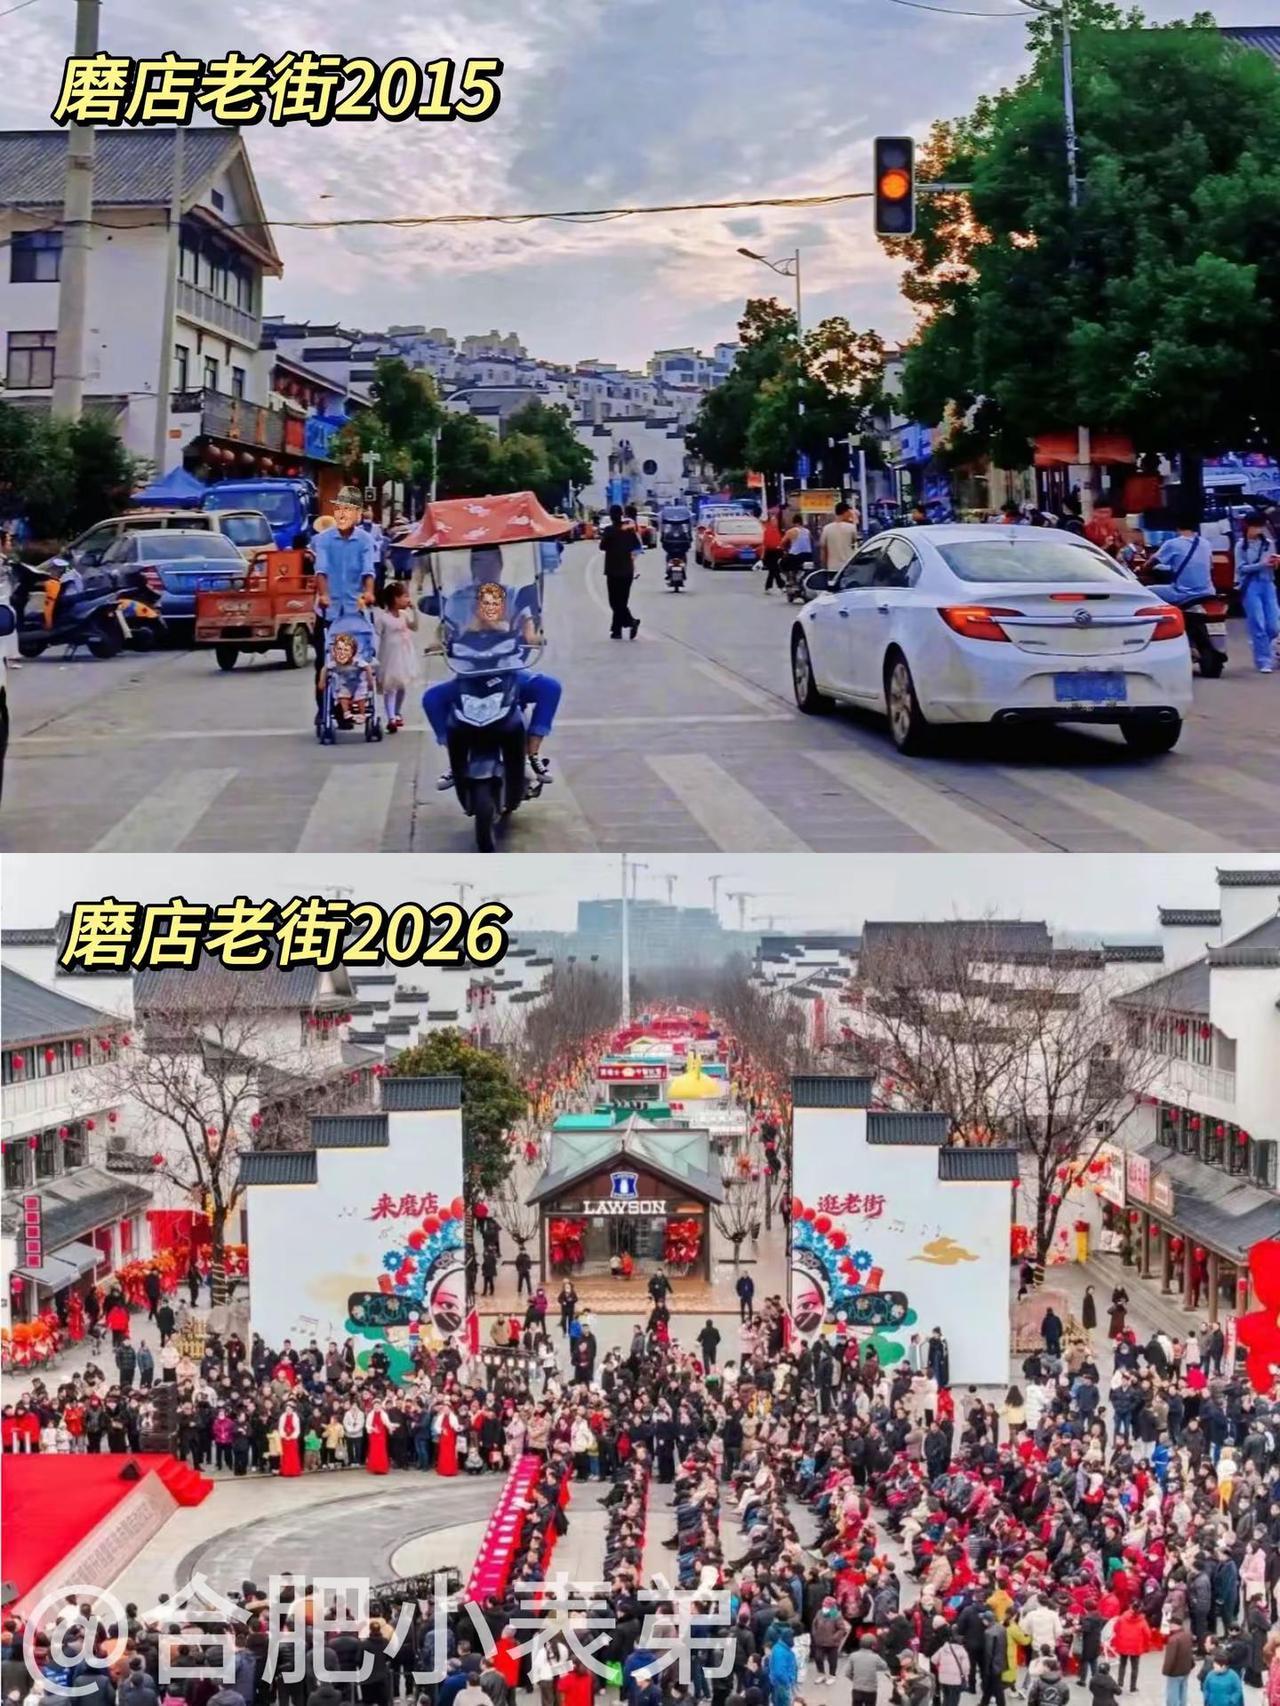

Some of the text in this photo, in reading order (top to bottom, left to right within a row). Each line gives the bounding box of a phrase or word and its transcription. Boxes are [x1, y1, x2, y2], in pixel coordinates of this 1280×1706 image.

[369, 1192, 439, 1220] 来磨店
[583, 1200, 667, 1215] LAWSON
[817, 1193, 886, 1219] 逛老街
